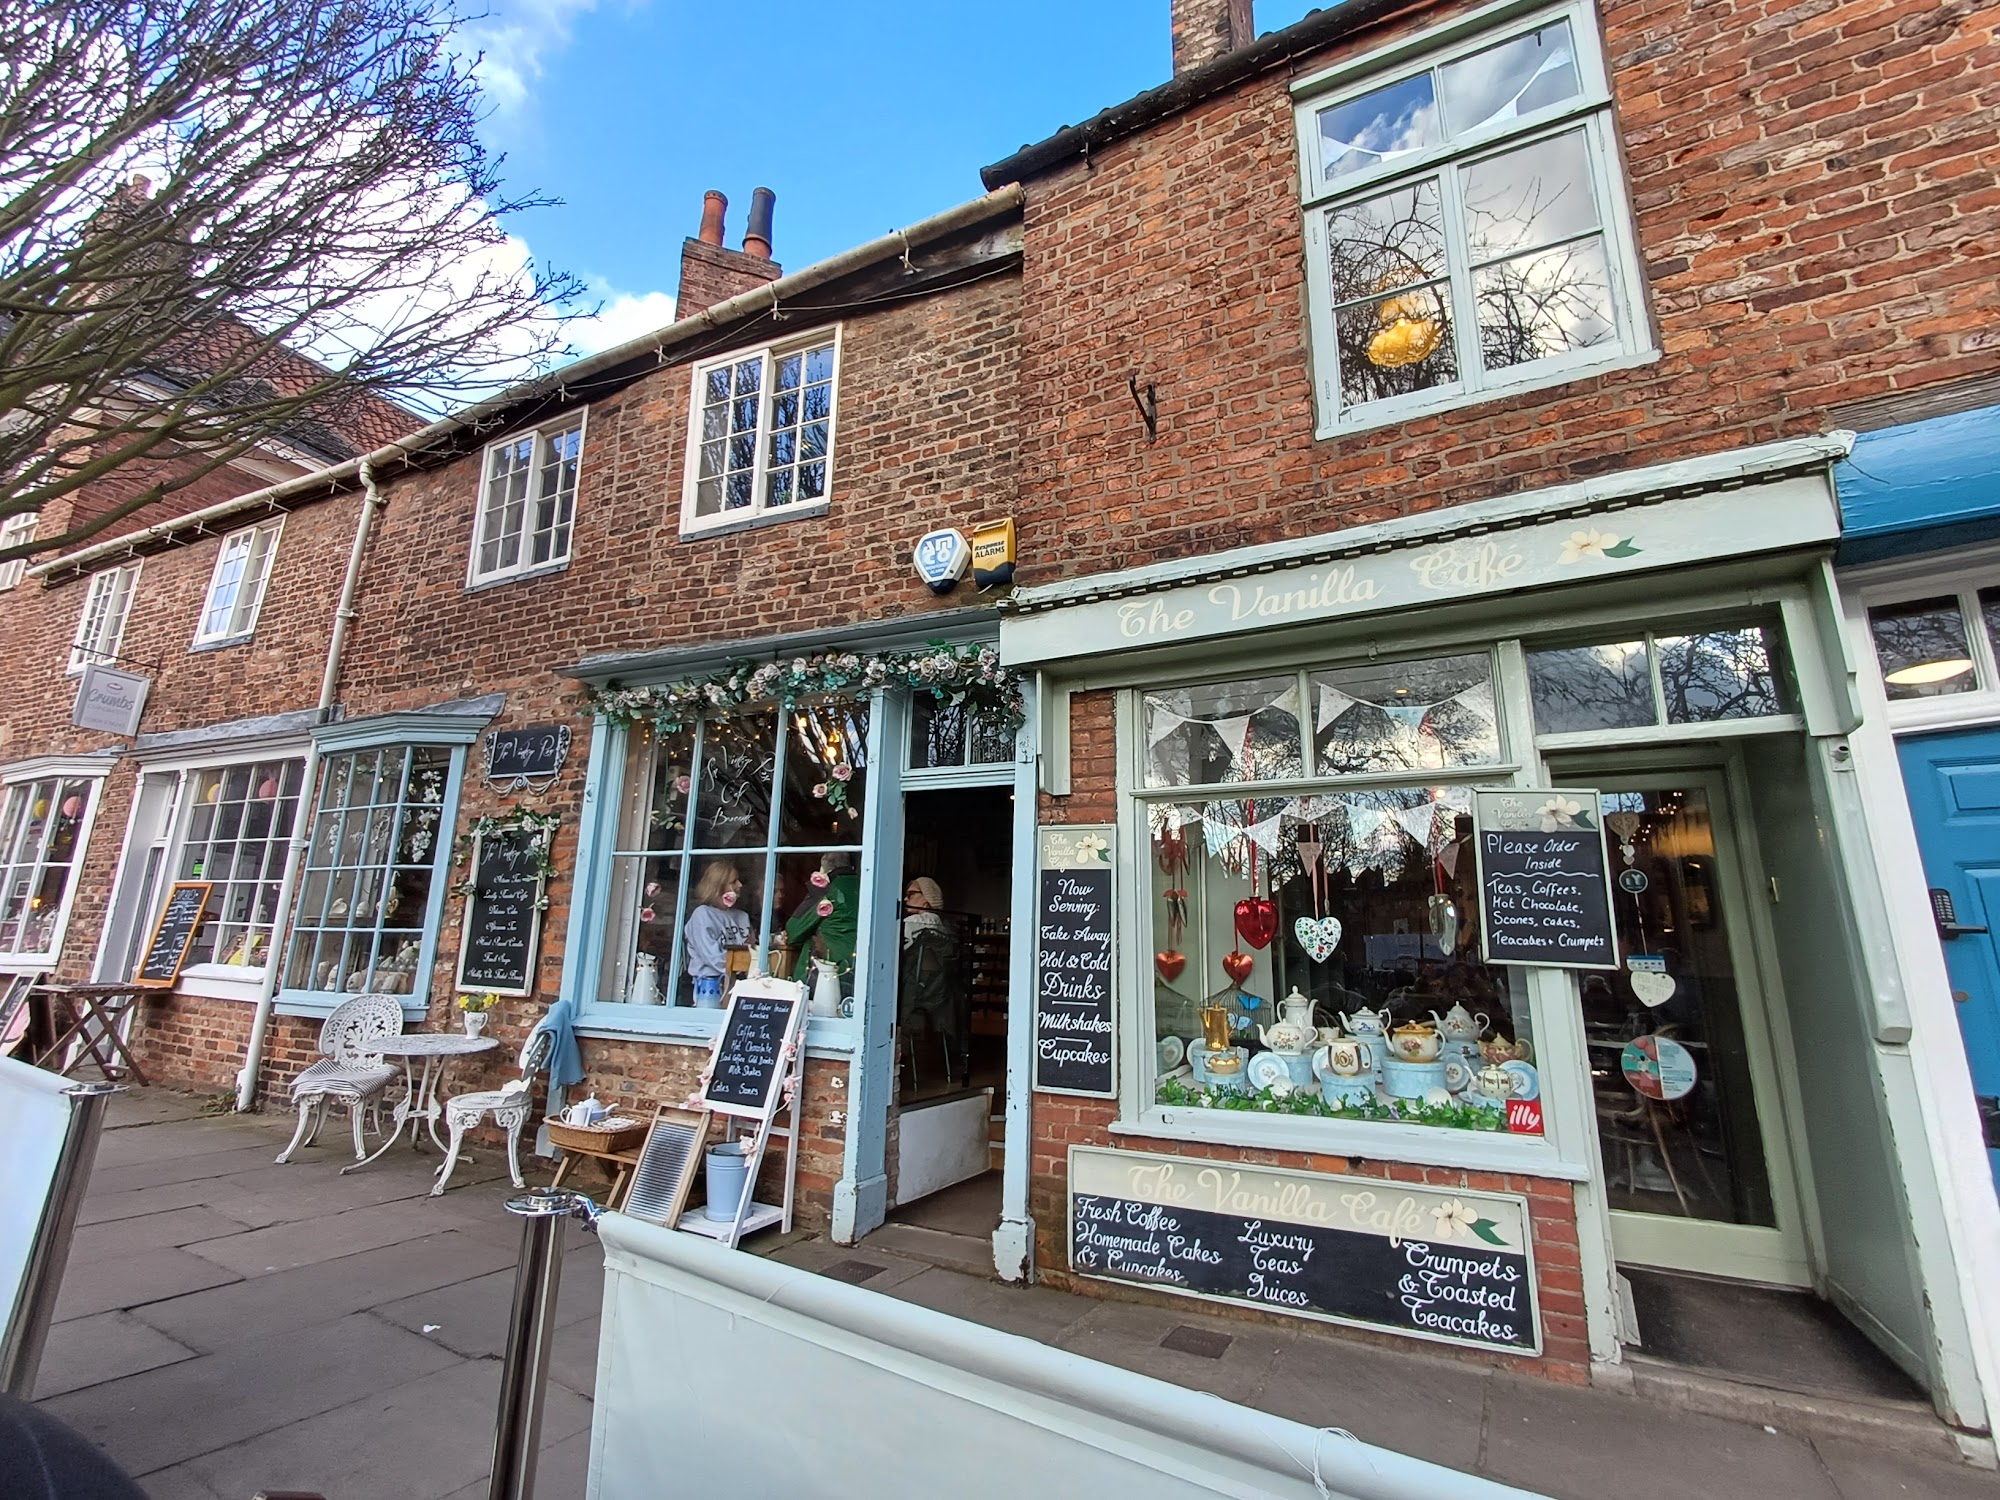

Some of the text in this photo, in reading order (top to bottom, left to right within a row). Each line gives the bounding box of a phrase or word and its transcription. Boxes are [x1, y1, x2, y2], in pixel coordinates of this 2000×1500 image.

[974, 546, 1005, 559] ALARMS
[1117, 541, 1524, 638] The Vanilla Café
[88, 688, 135, 711] Crumbs
[1043, 844, 1075, 857] Vanilla
[1050, 833, 1068, 845] The
[1486, 833, 1580, 854] Please Order
[1524, 856, 1562, 871] Inside
[1057, 878, 1094, 896] Now
[1486, 878, 1527, 896] Teas,
[1492, 895, 1515, 909] Hot
[1493, 910, 1538, 927] Scones,
[1041, 924, 1111, 950] Take Away
[1491, 929, 1547, 946] Teacakes
[1557, 933, 1605, 952] Crumpets
[1039, 950, 1112, 971] Hot & Cold
[1040, 971, 1106, 1000] Drinks
[737, 1023, 771, 1043] Coffee Tea
[1038, 1011, 1112, 1033] Milkshakes
[731, 1040, 742, 1053] Hot
[1038, 1039, 1111, 1068] Cupcakes
[1509, 1104, 1540, 1130] illy
[1076, 1196, 1182, 1232] Fresh Coffee
[1128, 1162, 1426, 1249] The Vanilla Café
[1075, 1220, 1224, 1265] Homemade Cakes
[1236, 1220, 1316, 1262] Luxury
[1250, 1245, 1304, 1274] Teas
[1402, 1240, 1521, 1285] Crumpets
[1246, 1271, 1310, 1307] Juices
[1397, 1268, 1517, 1312] & Toasted
[1400, 1293, 1519, 1340] Teacakes
